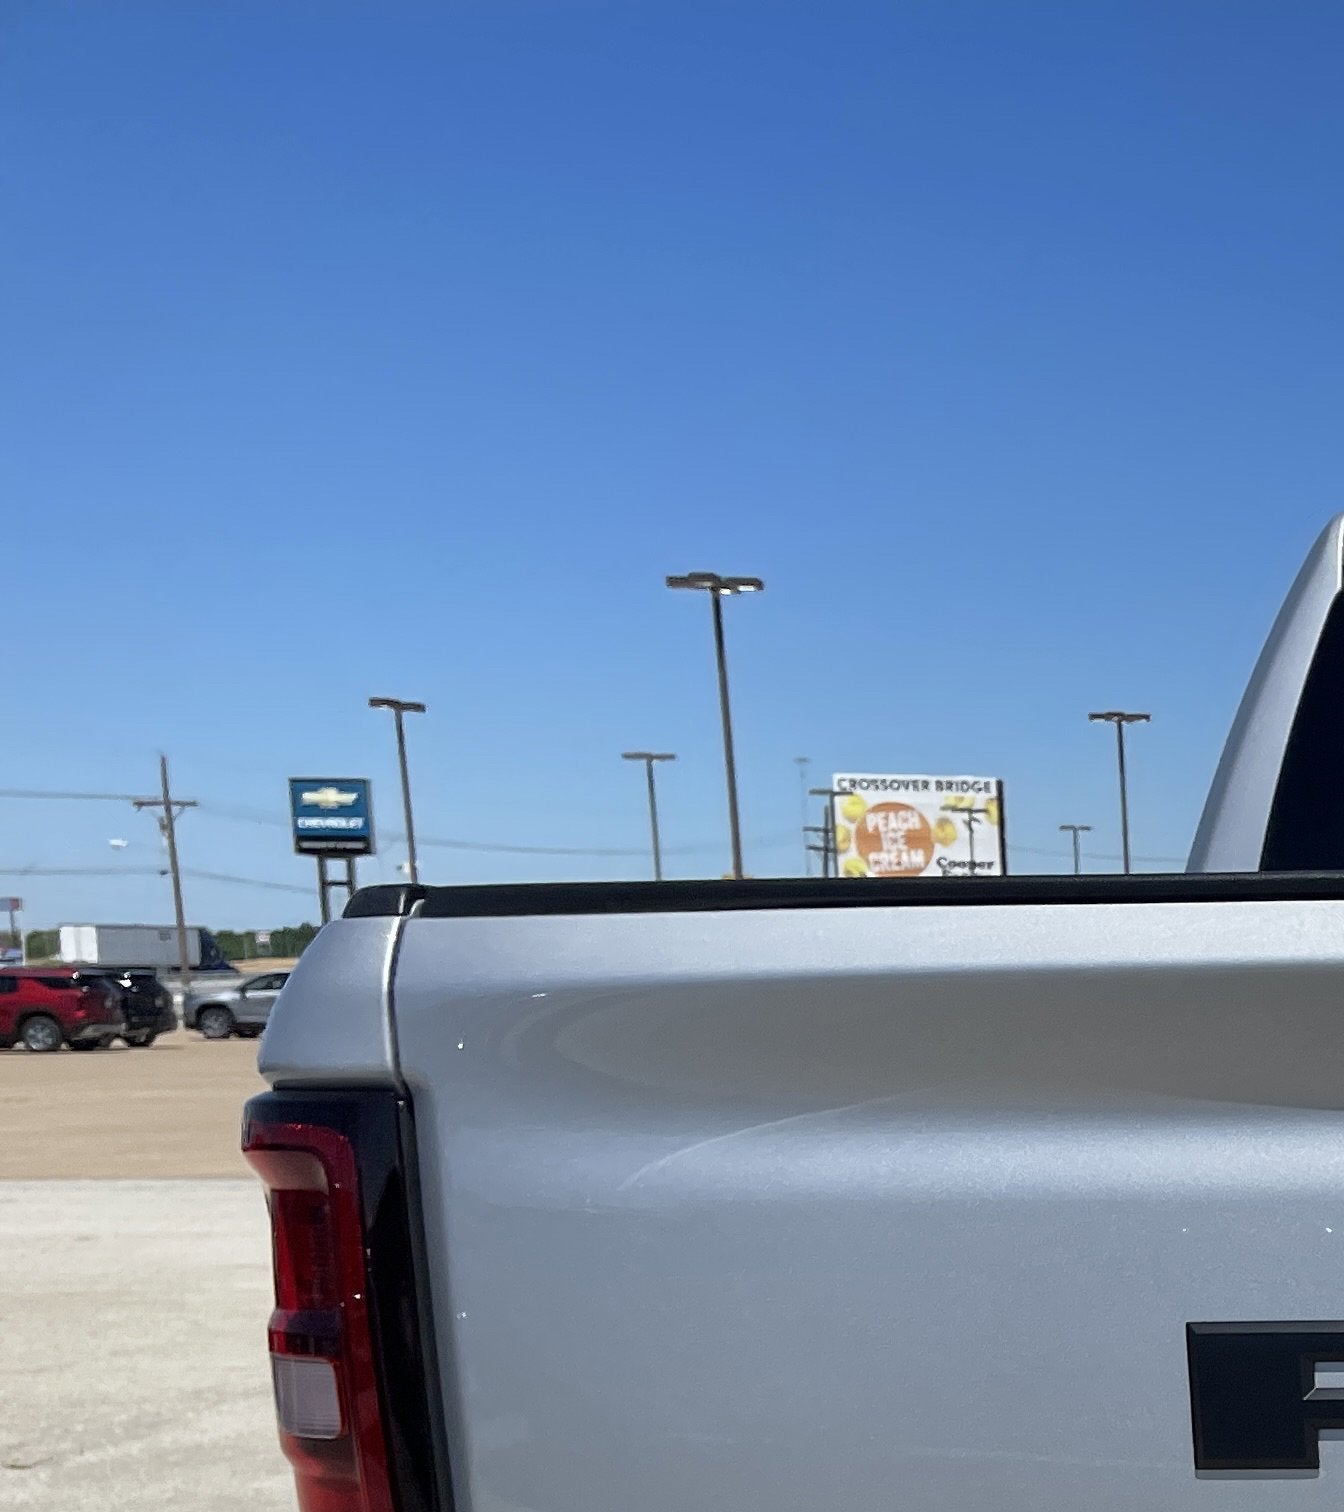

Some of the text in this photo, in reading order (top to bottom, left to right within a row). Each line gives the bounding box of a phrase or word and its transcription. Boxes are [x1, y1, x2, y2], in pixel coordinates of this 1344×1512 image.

[837, 777, 992, 793] CROSSOVER BRIDGE
[866, 810, 921, 832] PEACH
